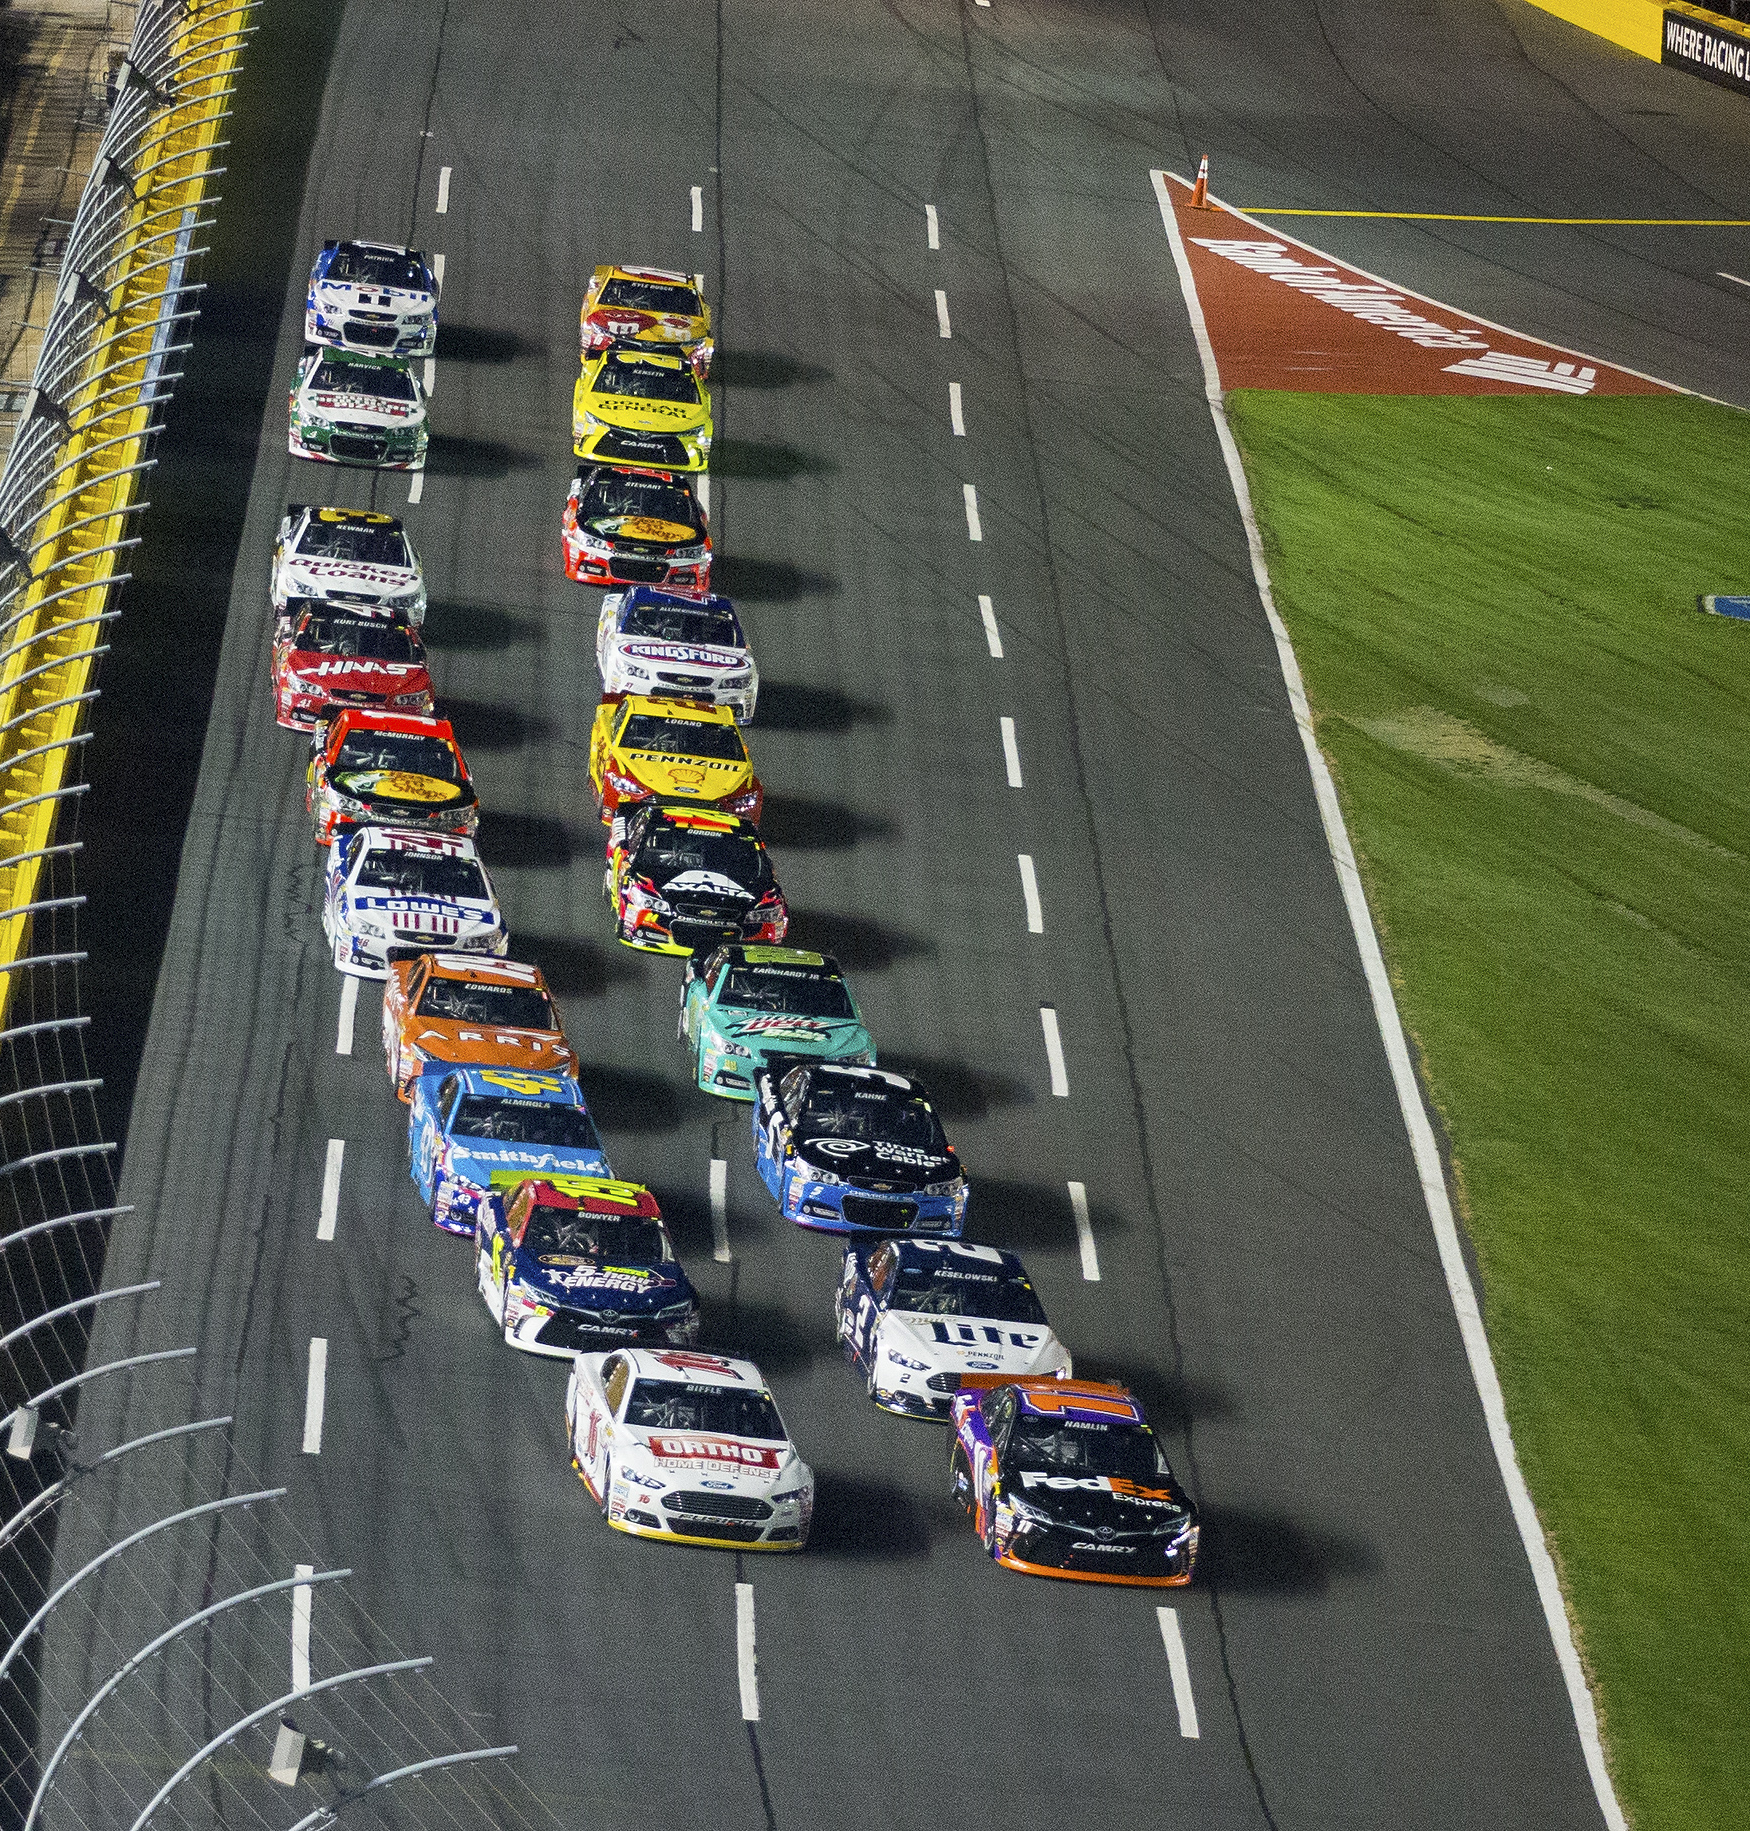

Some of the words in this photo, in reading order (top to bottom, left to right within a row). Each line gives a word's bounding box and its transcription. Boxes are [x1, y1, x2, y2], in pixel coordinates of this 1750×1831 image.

[1666, 20, 1703, 62] WHERE
[1703, 35, 1744, 78] RACING
[364, 254, 395, 263] PATRICK
[1187, 237, 1338, 275] Bank
[1269, 274, 1387, 291] of
[1299, 288, 1490, 349] America
[633, 368, 665, 378] KENSETH
[598, 403, 692, 421] GENERAL
[604, 400, 687, 414] DOLLAR
[620, 440, 664, 450] CAMRY
[624, 481, 662, 490] STEWART
[336, 524, 375, 534] NEWMAN
[288, 558, 418, 581] Quicken
[309, 567, 410, 587] Loans
[333, 618, 357, 627] KURT
[358, 620, 387, 629] BUSCH
[630, 644, 738, 665] KINGSFORD
[296, 661, 424, 676] HAAS
[665, 718, 702, 727] LOGANO
[373, 730, 425, 741] McMURRAY
[630, 753, 740, 772] PENNZOIL
[390, 784, 448, 799] Shops
[687, 829, 722, 838] GORDON
[404, 851, 444, 861] JOHNSON
[661, 882, 756, 900] AXALTA
[367, 898, 484, 921] LOWE'S
[752, 967, 807, 979] EARNHARDT
[465, 983, 513, 994] EDWARDS
[417, 1030, 571, 1058] ARRIS
[854, 1091, 887, 1101] KAHNE
[501, 1098, 550, 1109] ALMIROLA
[872, 1140, 925, 1154] Time
[874, 1145, 950, 1163] Warner
[453, 1147, 605, 1175] Smithfield
[875, 1151, 941, 1168] Cable
[457, 1193, 471, 1205] 43
[578, 1211, 621, 1222] BOWYER
[573, 1265, 655, 1285] 5-hour
[933, 1269, 998, 1282] KESELOWSKI
[565, 1276, 653, 1294] ENERGY
[578, 1323, 638, 1336] CAMRY
[930, 1321, 1040, 1349] Lite
[899, 1373, 912, 1383] 2
[686, 1384, 723, 1395] BIFFLE
[1064, 1420, 1108, 1431] HAMLIN
[661, 1439, 752, 1463] ORTHO
[653, 1457, 704, 1471] HOME
[706, 1461, 782, 1480] DEFENSE
[1019, 1471, 1173, 1500] FedEx
[1112, 1492, 1181, 1513] Express
[1071, 1541, 1137, 1554] CAMRY
